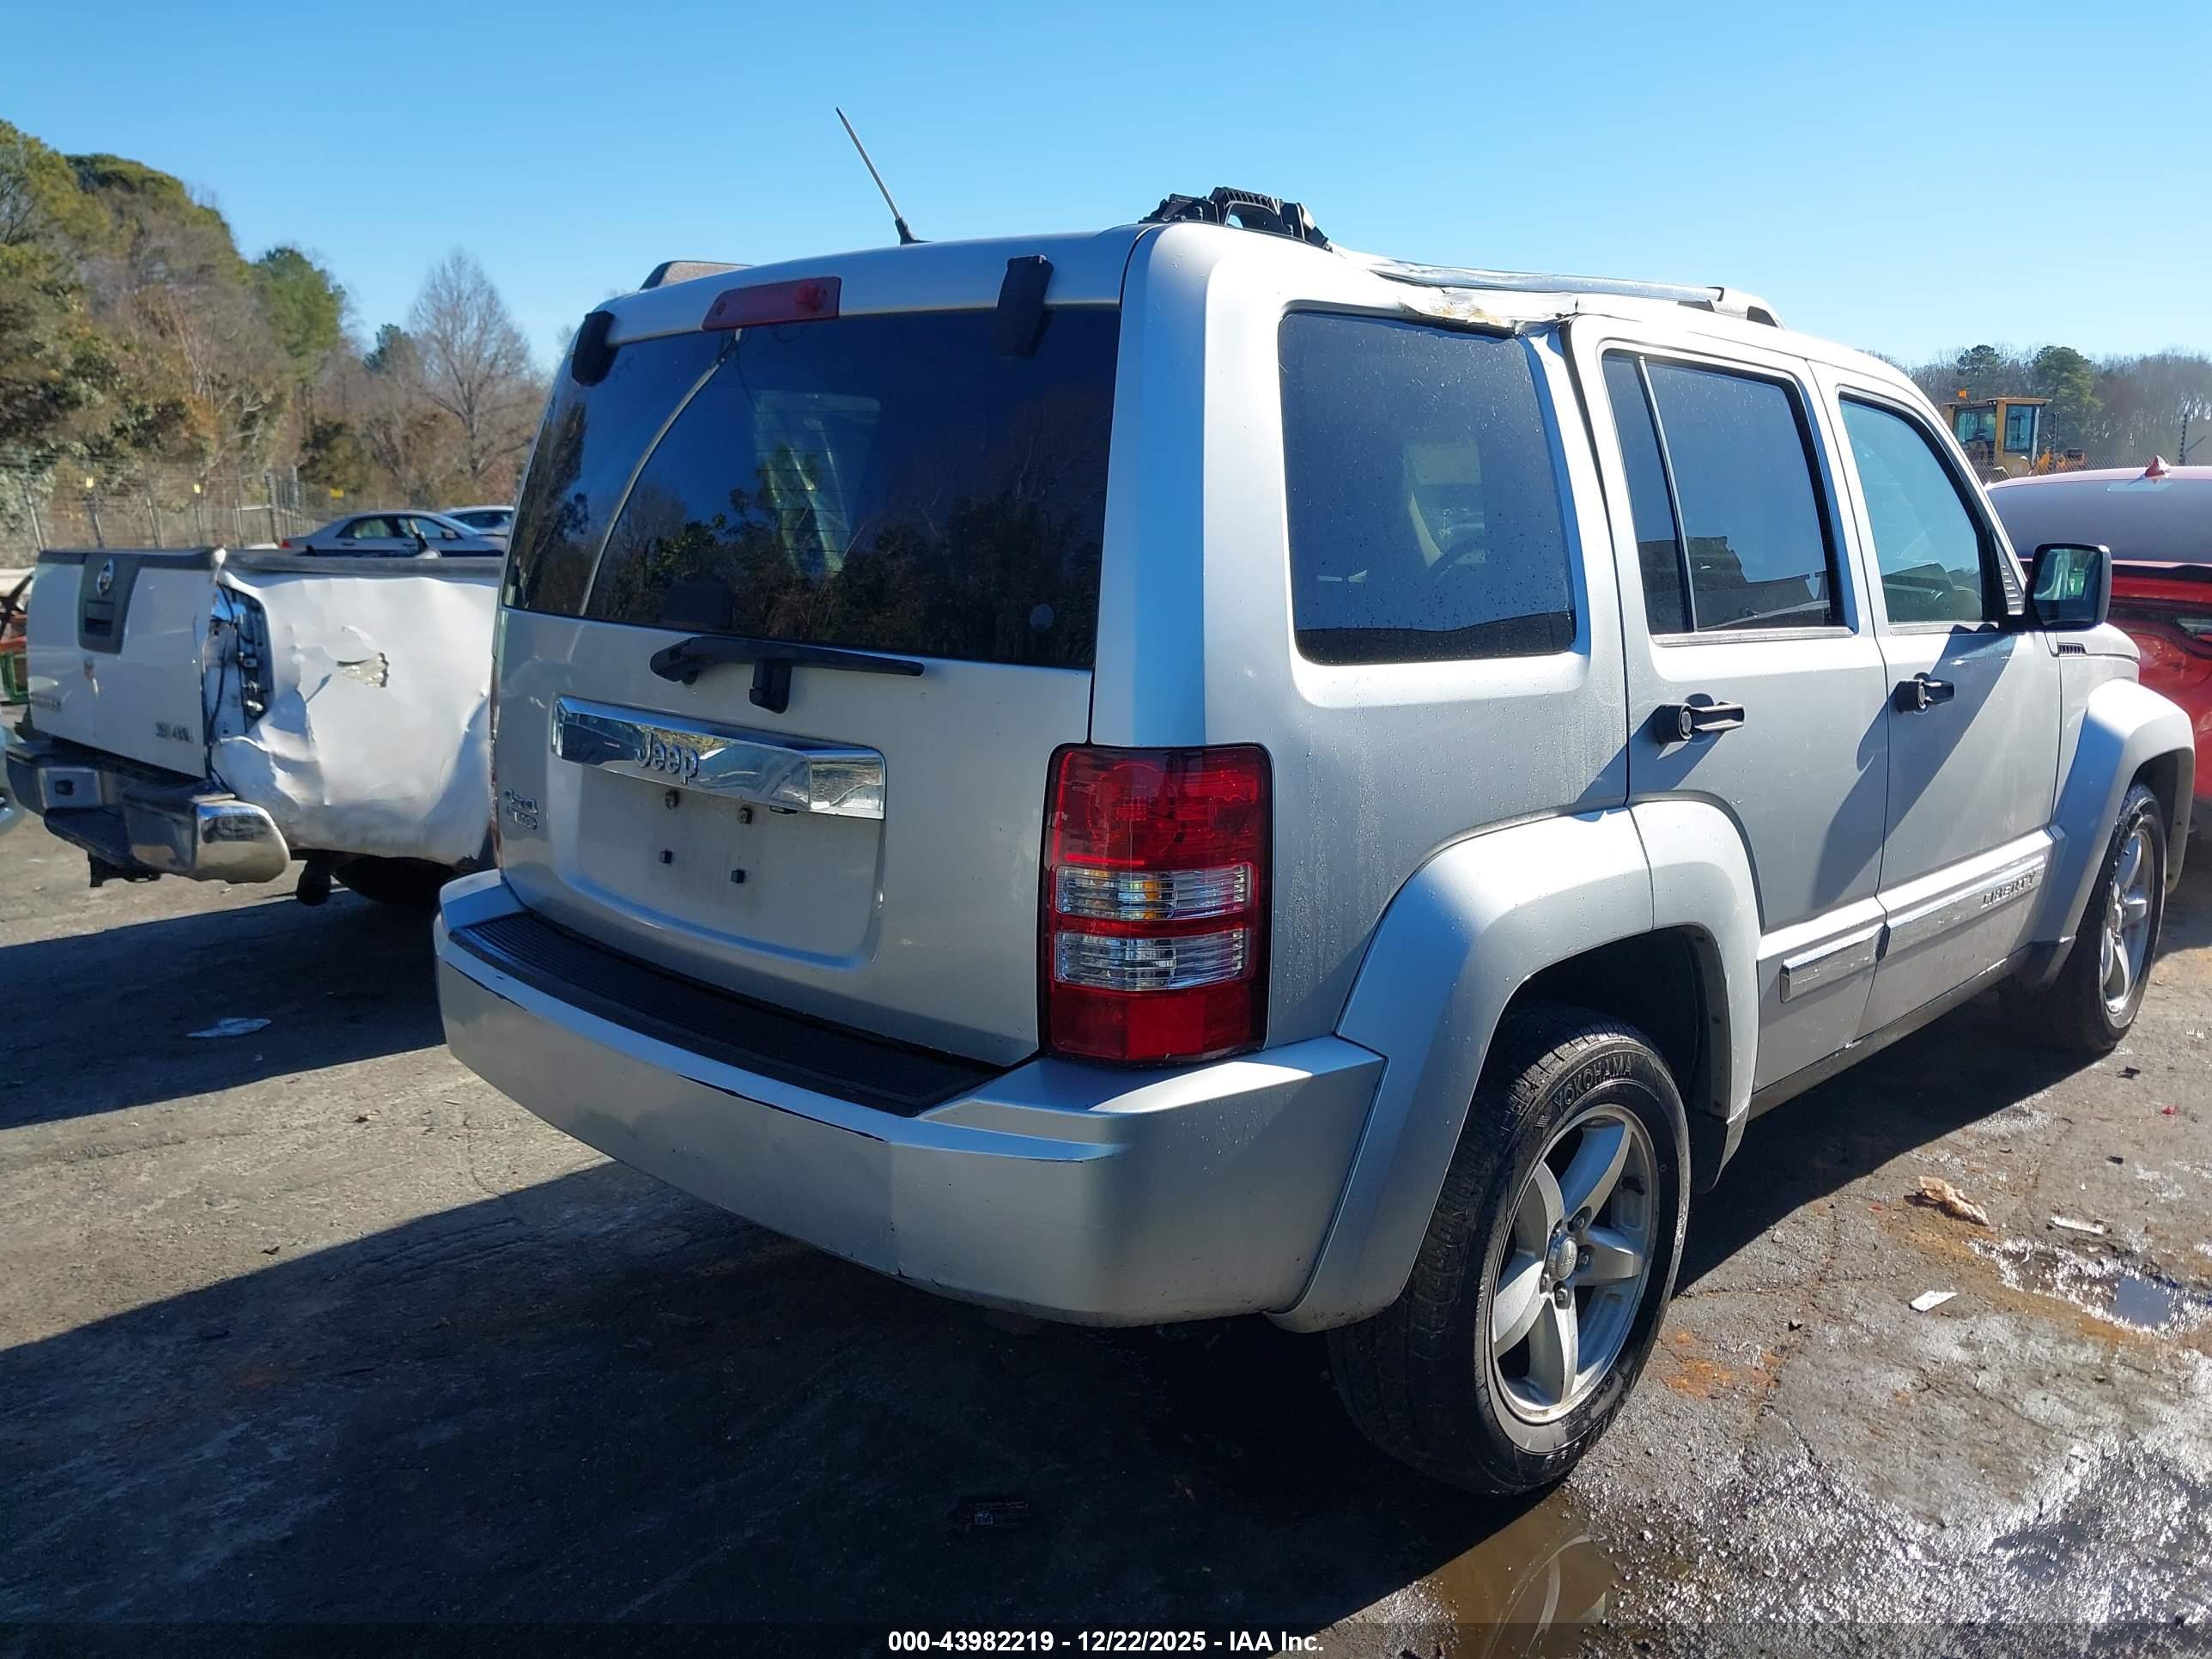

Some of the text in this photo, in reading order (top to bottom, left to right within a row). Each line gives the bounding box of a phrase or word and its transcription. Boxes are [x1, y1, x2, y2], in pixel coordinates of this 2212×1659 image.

[634, 732, 699, 785] Jeep
[1980, 871, 2037, 908] LIBERTY
[1553, 1054, 1632, 1113] YOKOHAMA
